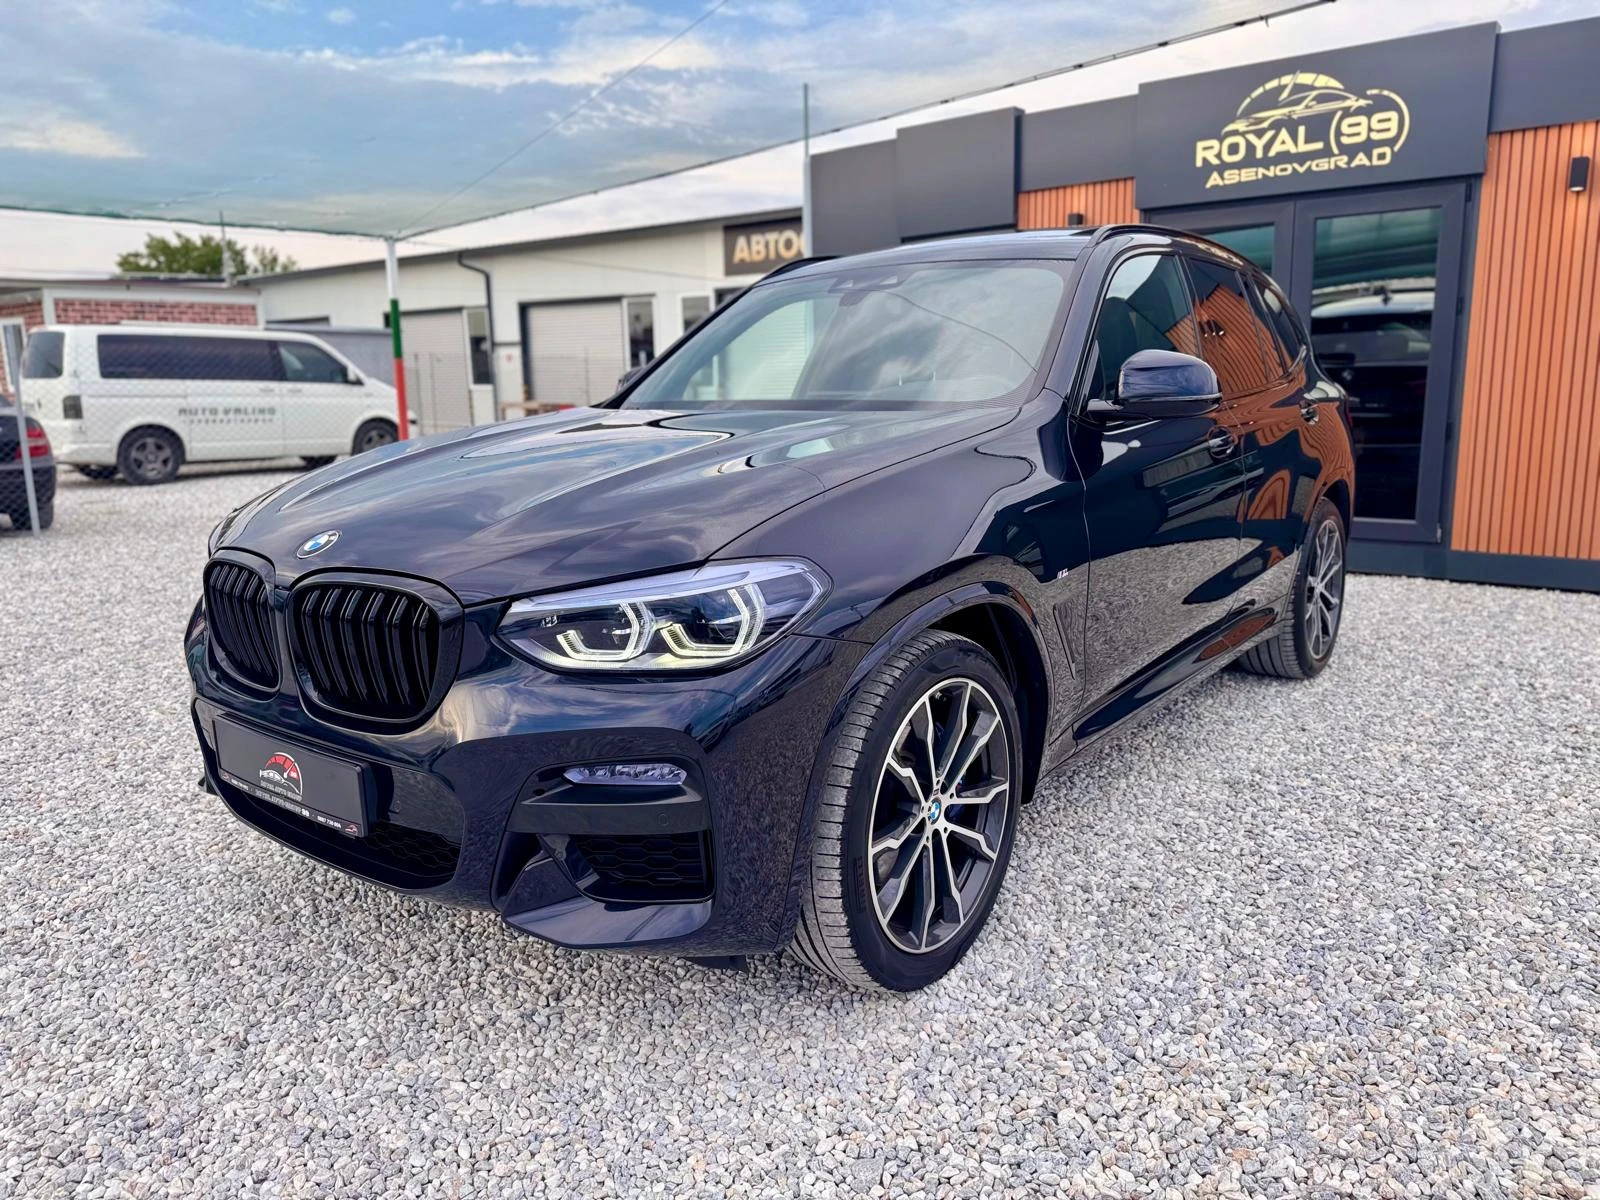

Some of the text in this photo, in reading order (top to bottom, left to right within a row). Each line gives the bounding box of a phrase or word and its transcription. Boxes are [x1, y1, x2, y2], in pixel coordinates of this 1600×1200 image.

[1195, 125, 1324, 168] ROYAL
[1205, 146, 1392, 189] ASENOVGRAD
[732, 229, 804, 264] АВТО
